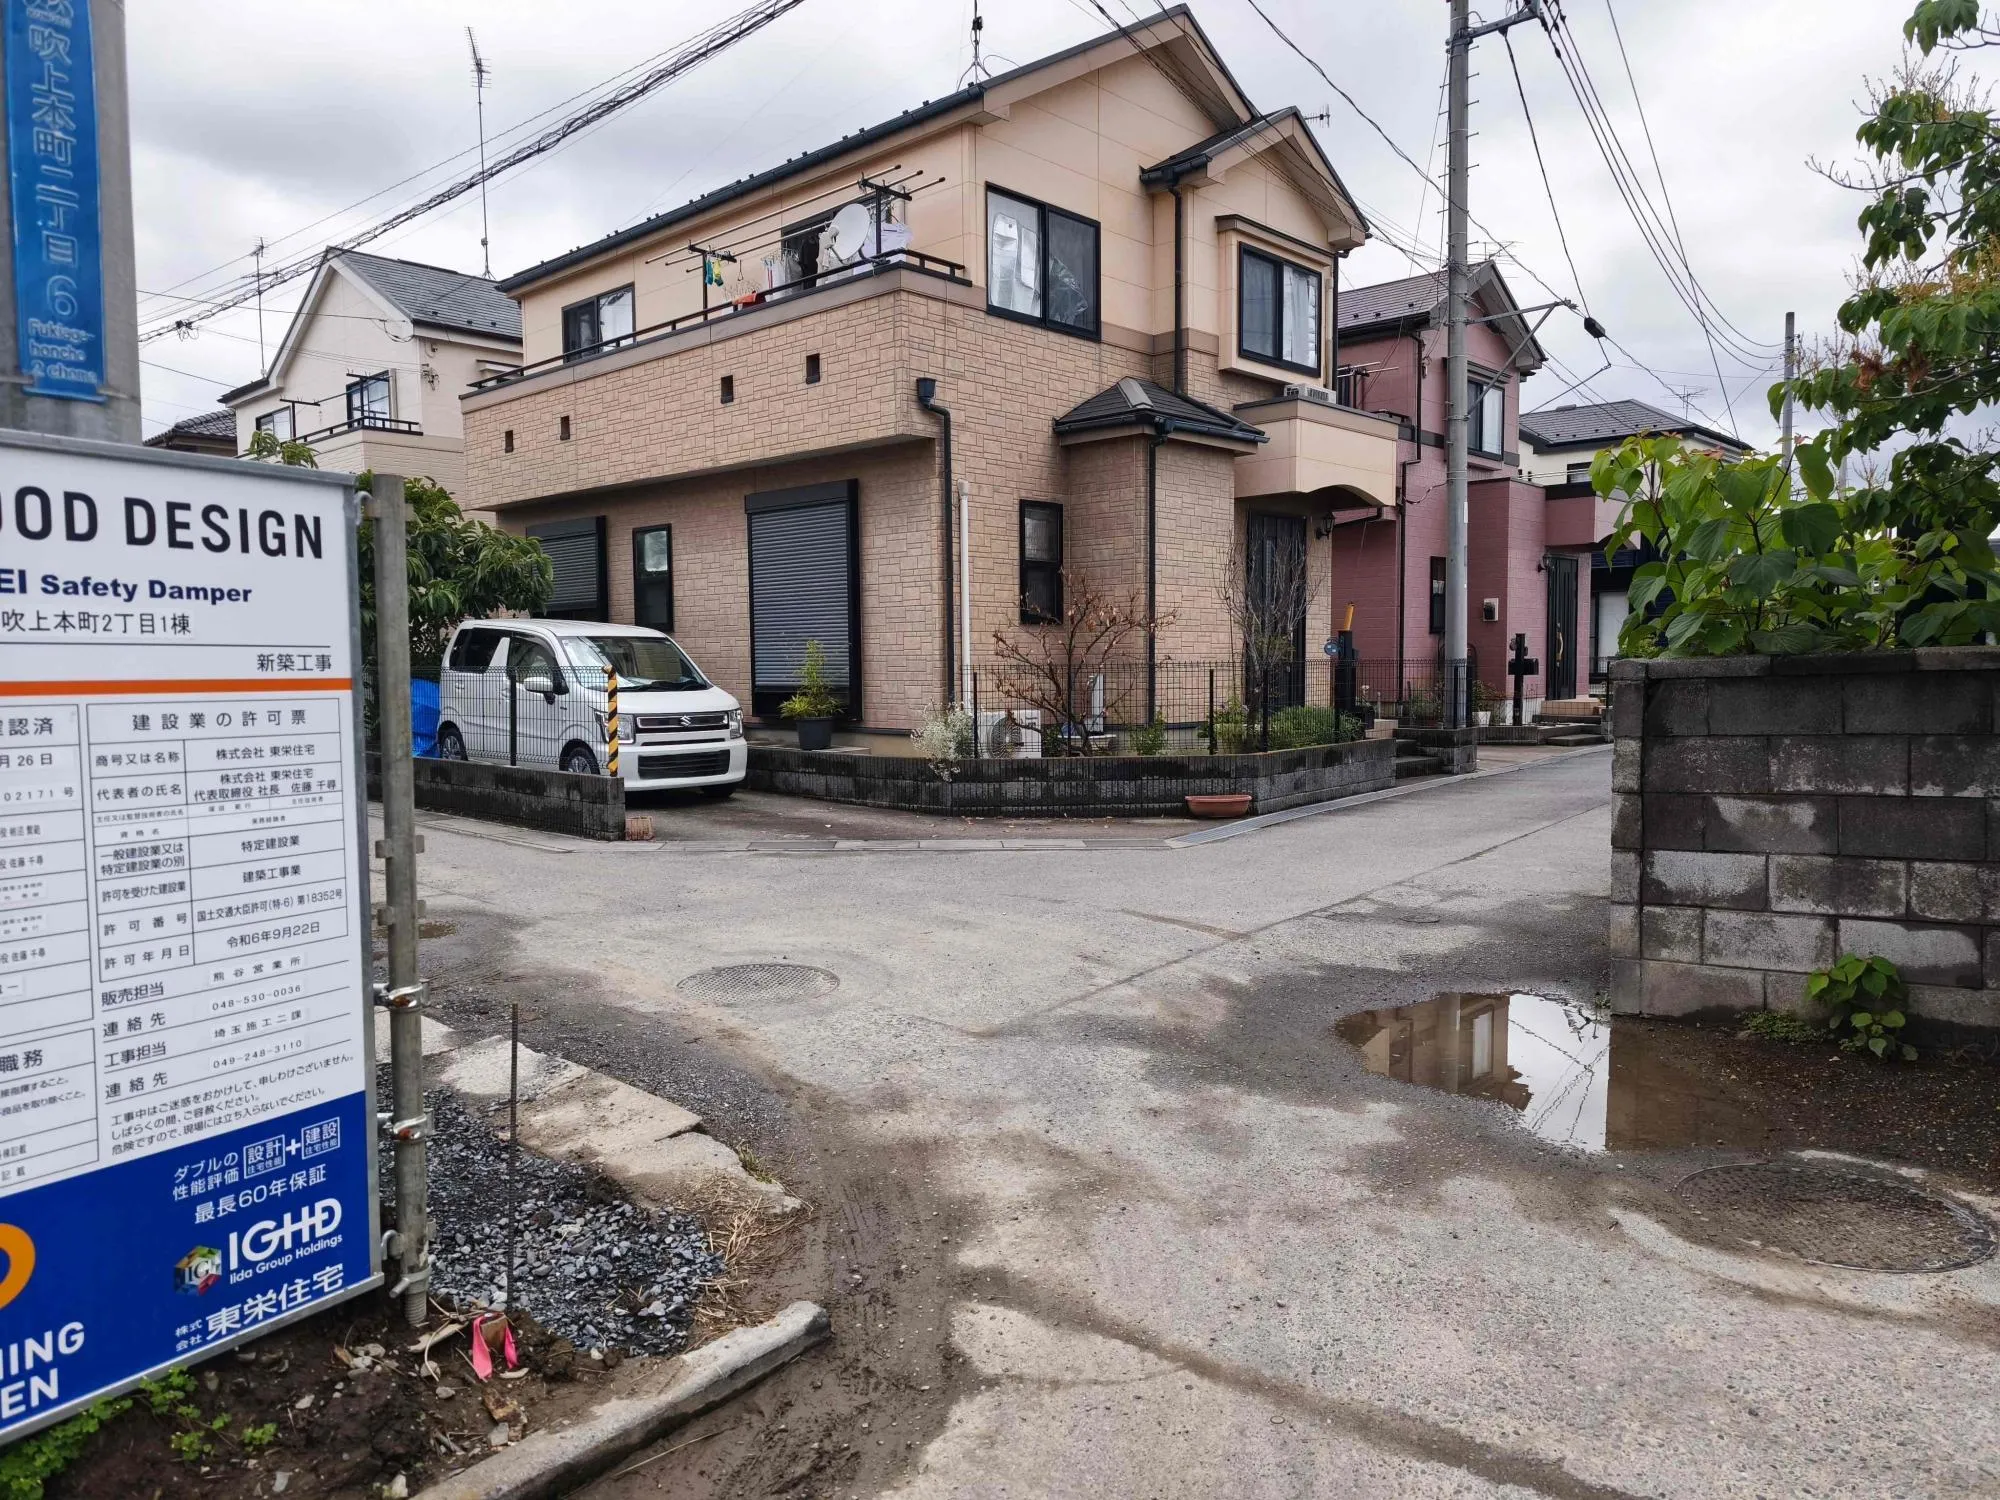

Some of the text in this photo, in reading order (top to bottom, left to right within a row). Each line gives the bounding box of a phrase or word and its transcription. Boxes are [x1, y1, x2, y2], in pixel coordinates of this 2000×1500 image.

[0, 486, 323, 559] OD DESIGN
[41, 574, 138, 602] Safety
[148, 579, 252, 605] Damper
[2, 609, 191, 635] 吹上本町2丁目1棟
[257, 653, 331, 672] 新築工事
[0, 717, 53, 736] 認済
[132, 709, 306, 731] 建設業の許可票
[96, 751, 180, 767] 商号又は名称
[216, 744, 315, 760] 株式会社 東栄住宅
[220, 768, 313, 785] 株式会社 東栄住宅
[97, 784, 181, 801] 代表者の氏名
[194, 787, 253, 802] 代表取締役
[101, 842, 184, 861] 一般建設業又は
[241, 835, 300, 852] 特定建設業
[101, 855, 185, 876] 特定建設業の別
[243, 865, 301, 883] 建築工事業
[102, 881, 186, 903] 許可を受けた建設業
[104, 913, 187, 936] 許可番号
[227, 921, 320, 949] 令和6年9月22日
[104, 945, 189, 970] 許可年月日
[213, 956, 300, 982] 熊谷営業所
[101, 981, 164, 1007] 販売担当
[103, 1012, 165, 1038] 連絡先
[104, 1042, 166, 1068] 工事担当
[105, 1072, 167, 1099] 連絡先
[305, 1121, 337, 1146] 建設
[247, 1140, 282, 1165] 設計
[173, 1152, 239, 1184] ダブルの
[172, 1167, 240, 1202] 性能評価
[194, 1163, 327, 1225] 最長60年保証
[229, 1198, 342, 1271] IGHD
[256, 1254, 293, 1275] Group
[295, 1234, 343, 1260] Holdings
[205, 1262, 345, 1341] 東栄住宅
[175, 1318, 203, 1338] 株式
[0, 1321, 85, 1381] ING
[176, 1334, 203, 1352] 会社
